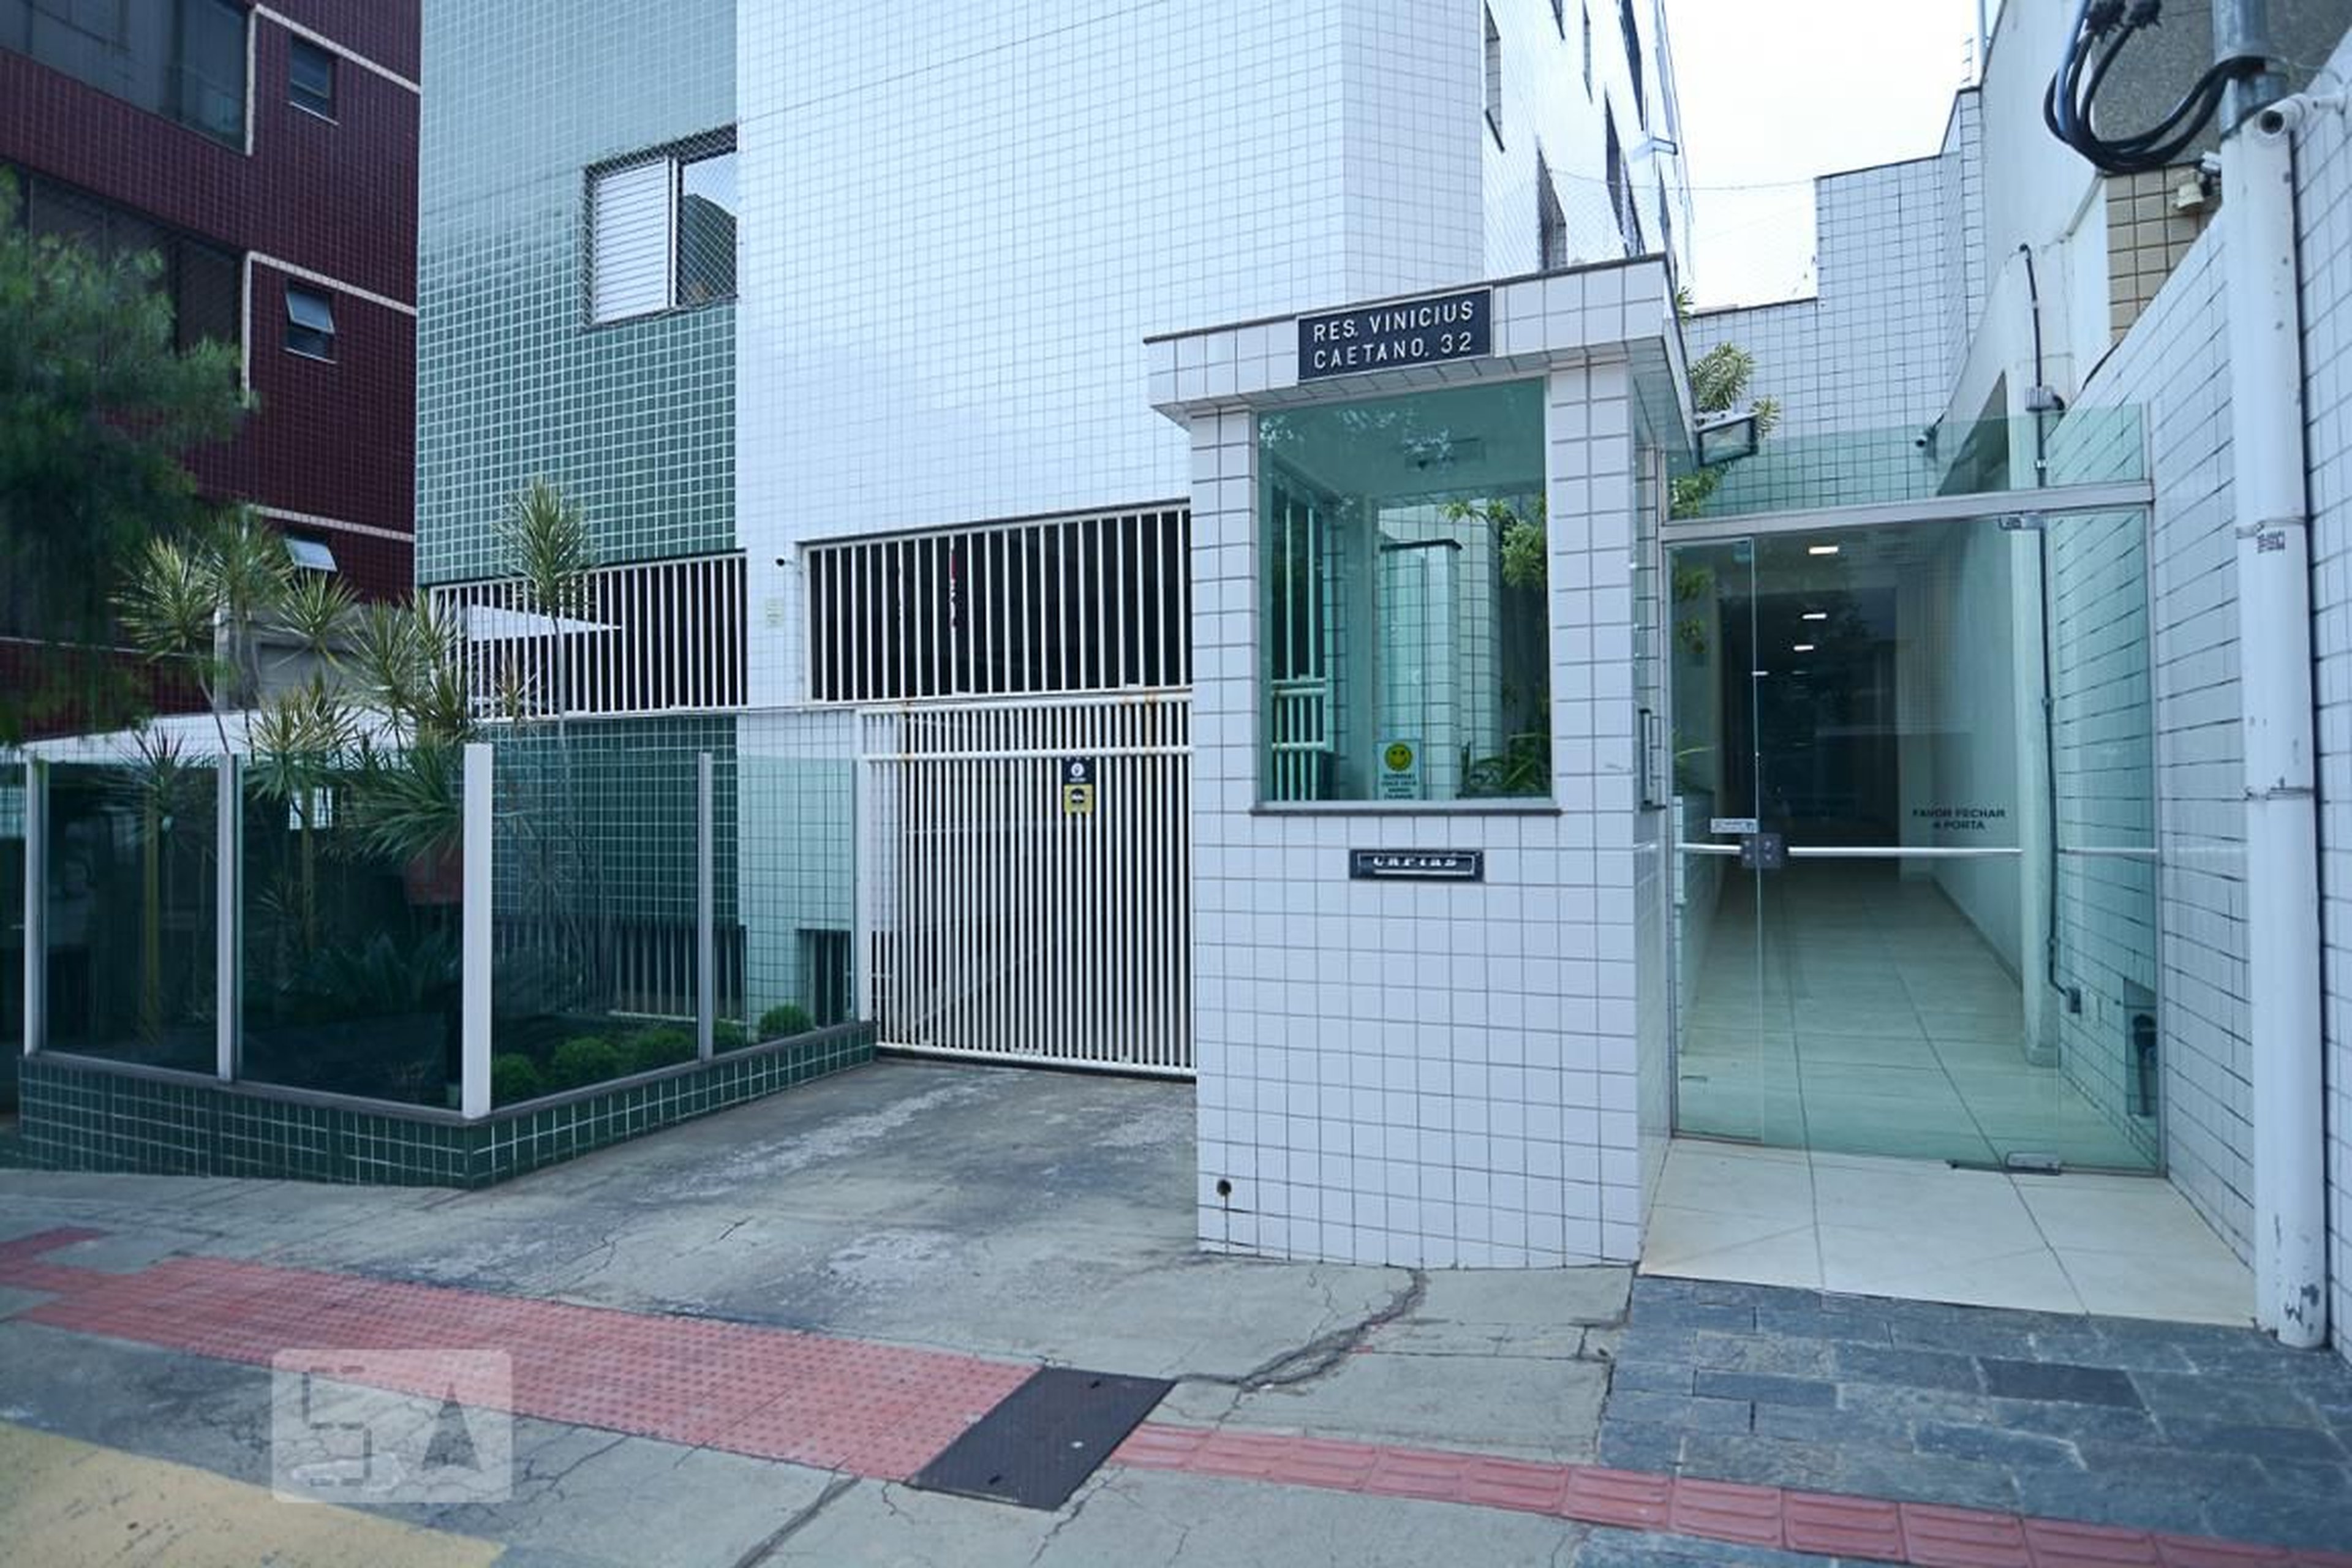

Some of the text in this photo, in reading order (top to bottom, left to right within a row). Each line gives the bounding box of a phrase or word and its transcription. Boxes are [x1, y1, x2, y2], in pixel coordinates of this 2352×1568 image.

[1313, 300, 1474, 342] RES. VINICIUS
[1441, 331, 1471, 354] 32
[1956, 807, 2006, 818] FECHAR
[1943, 820, 1985, 830] PORTA
